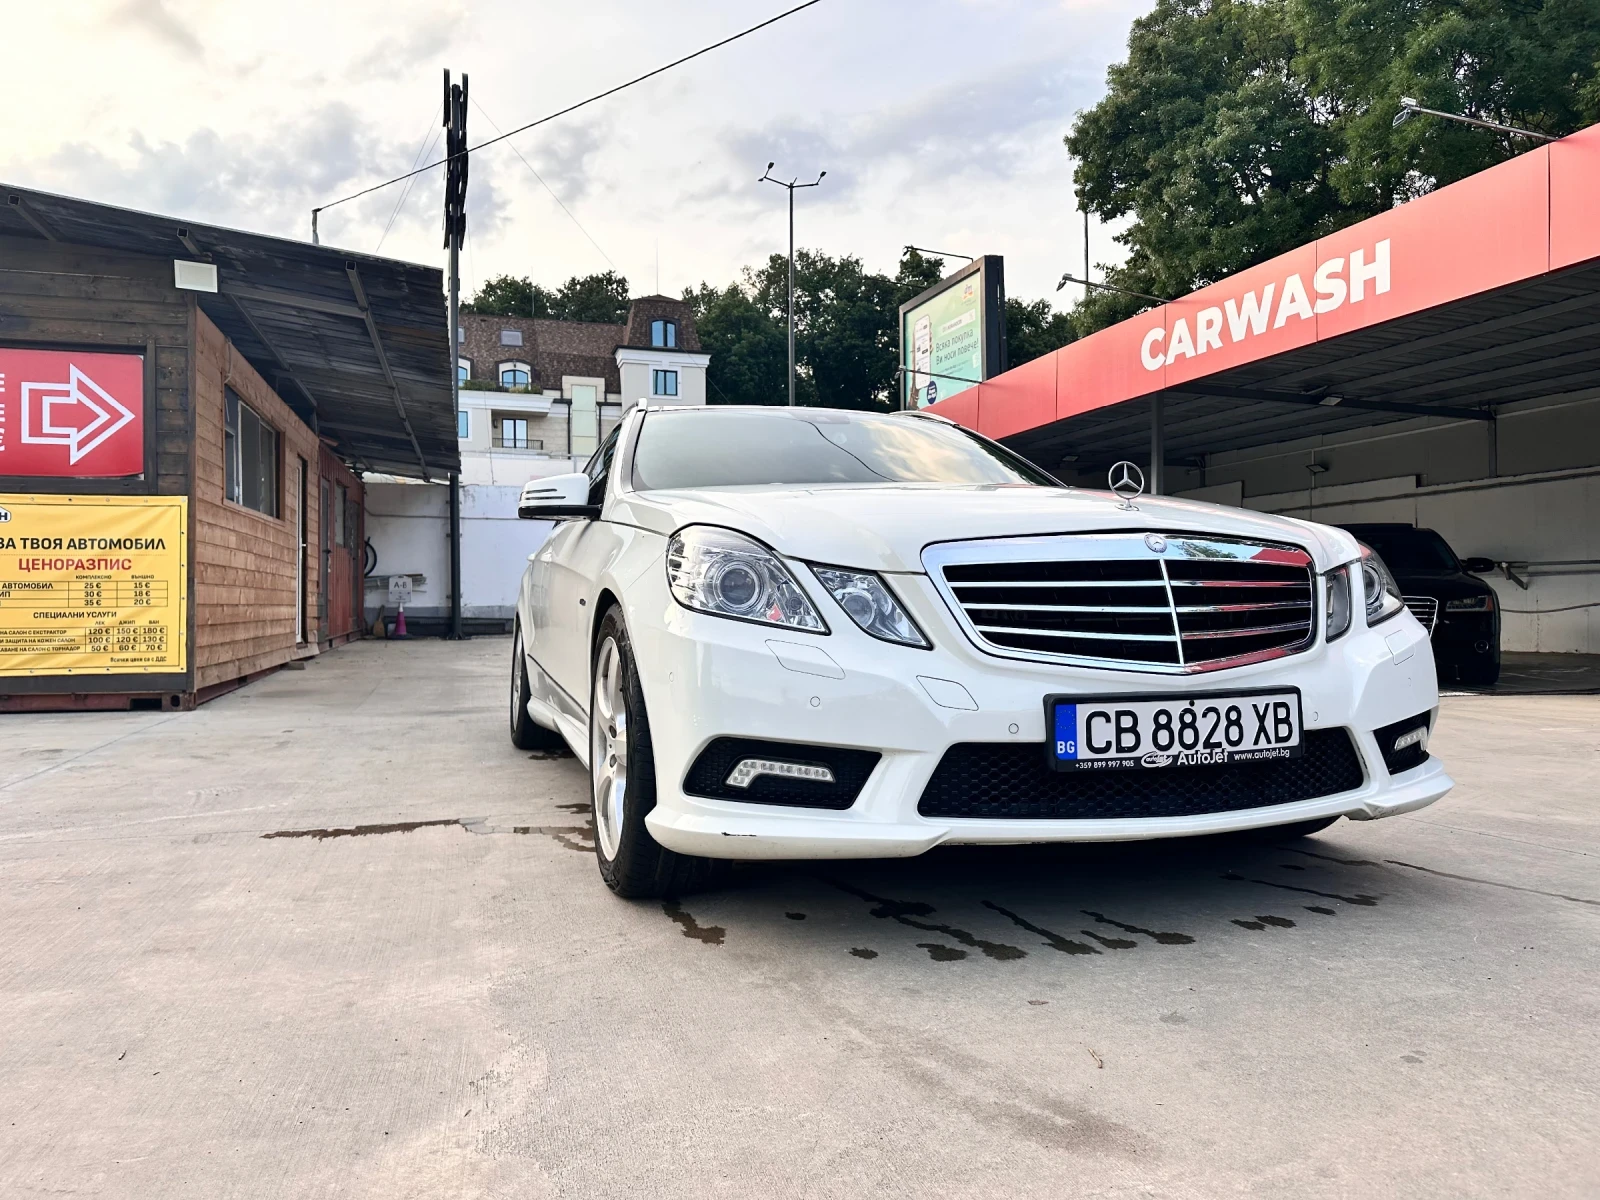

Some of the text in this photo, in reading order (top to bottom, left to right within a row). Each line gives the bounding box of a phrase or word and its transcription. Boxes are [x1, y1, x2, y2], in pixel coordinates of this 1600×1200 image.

[1140, 238, 1391, 371] CARWASH
[936, 340, 950, 353] Всяка
[952, 329, 974, 345] покупка
[936, 338, 979, 366] Ви носи повече!
[20, 538, 62, 550] ТВОЯ
[66, 538, 166, 550] АВТОМОБИЛ
[18, 558, 132, 572] ЦЕНОРАЗПИС
[2, 582, 53, 590] АВТОМОБИЛ
[1085, 702, 1294, 754] CB 8828 XB
[1057, 740, 1075, 754] BG
[1234, 748, 1290, 760] www.autojet.bg
[1108, 760, 1120, 768] 997
[1177, 749, 1228, 766] AutoJet
